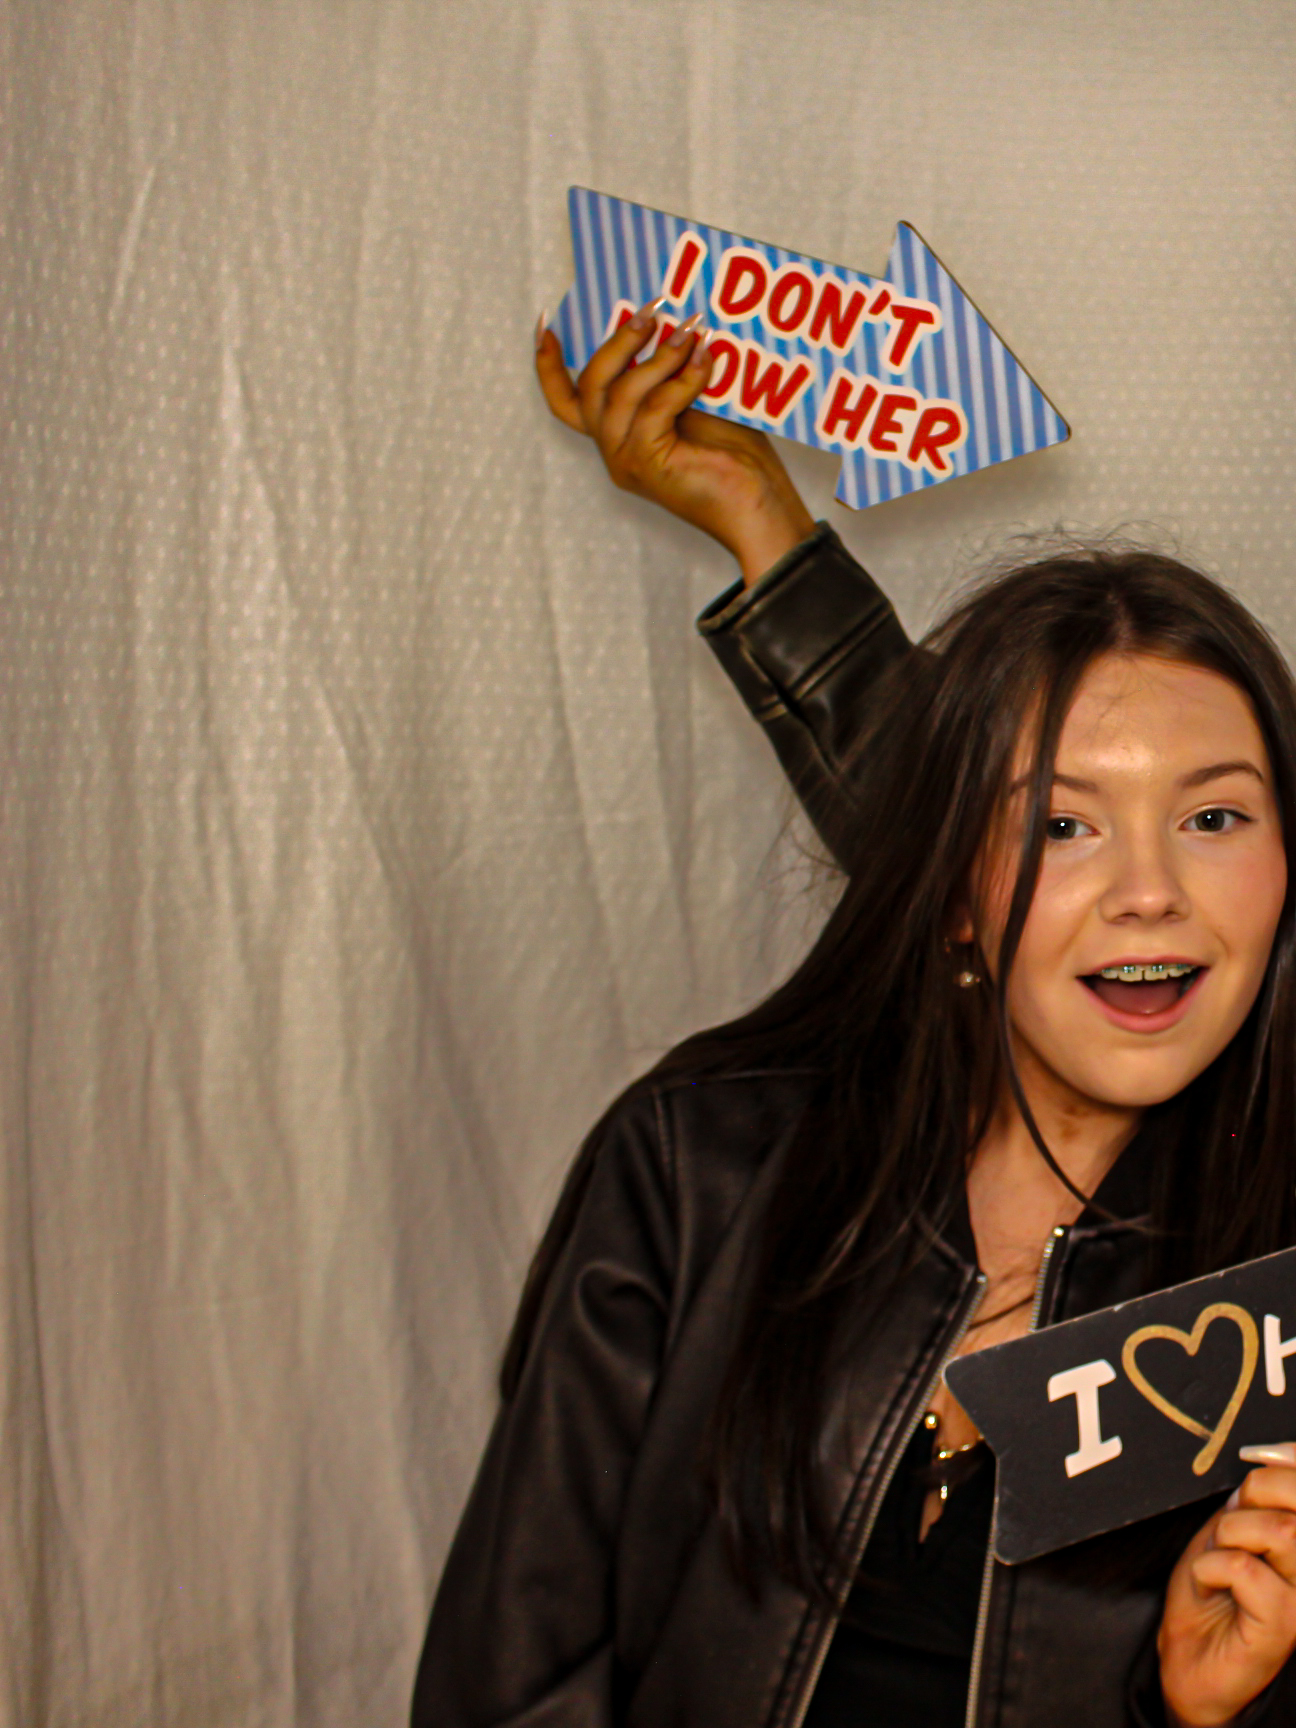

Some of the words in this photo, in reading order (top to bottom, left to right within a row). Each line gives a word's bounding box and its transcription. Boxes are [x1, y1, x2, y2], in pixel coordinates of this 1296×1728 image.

[668, 237, 702, 301] I
[716, 253, 936, 369] DON'T
[611, 306, 812, 420] OW
[820, 374, 964, 473] HER
[1046, 1358, 1124, 1479] I
